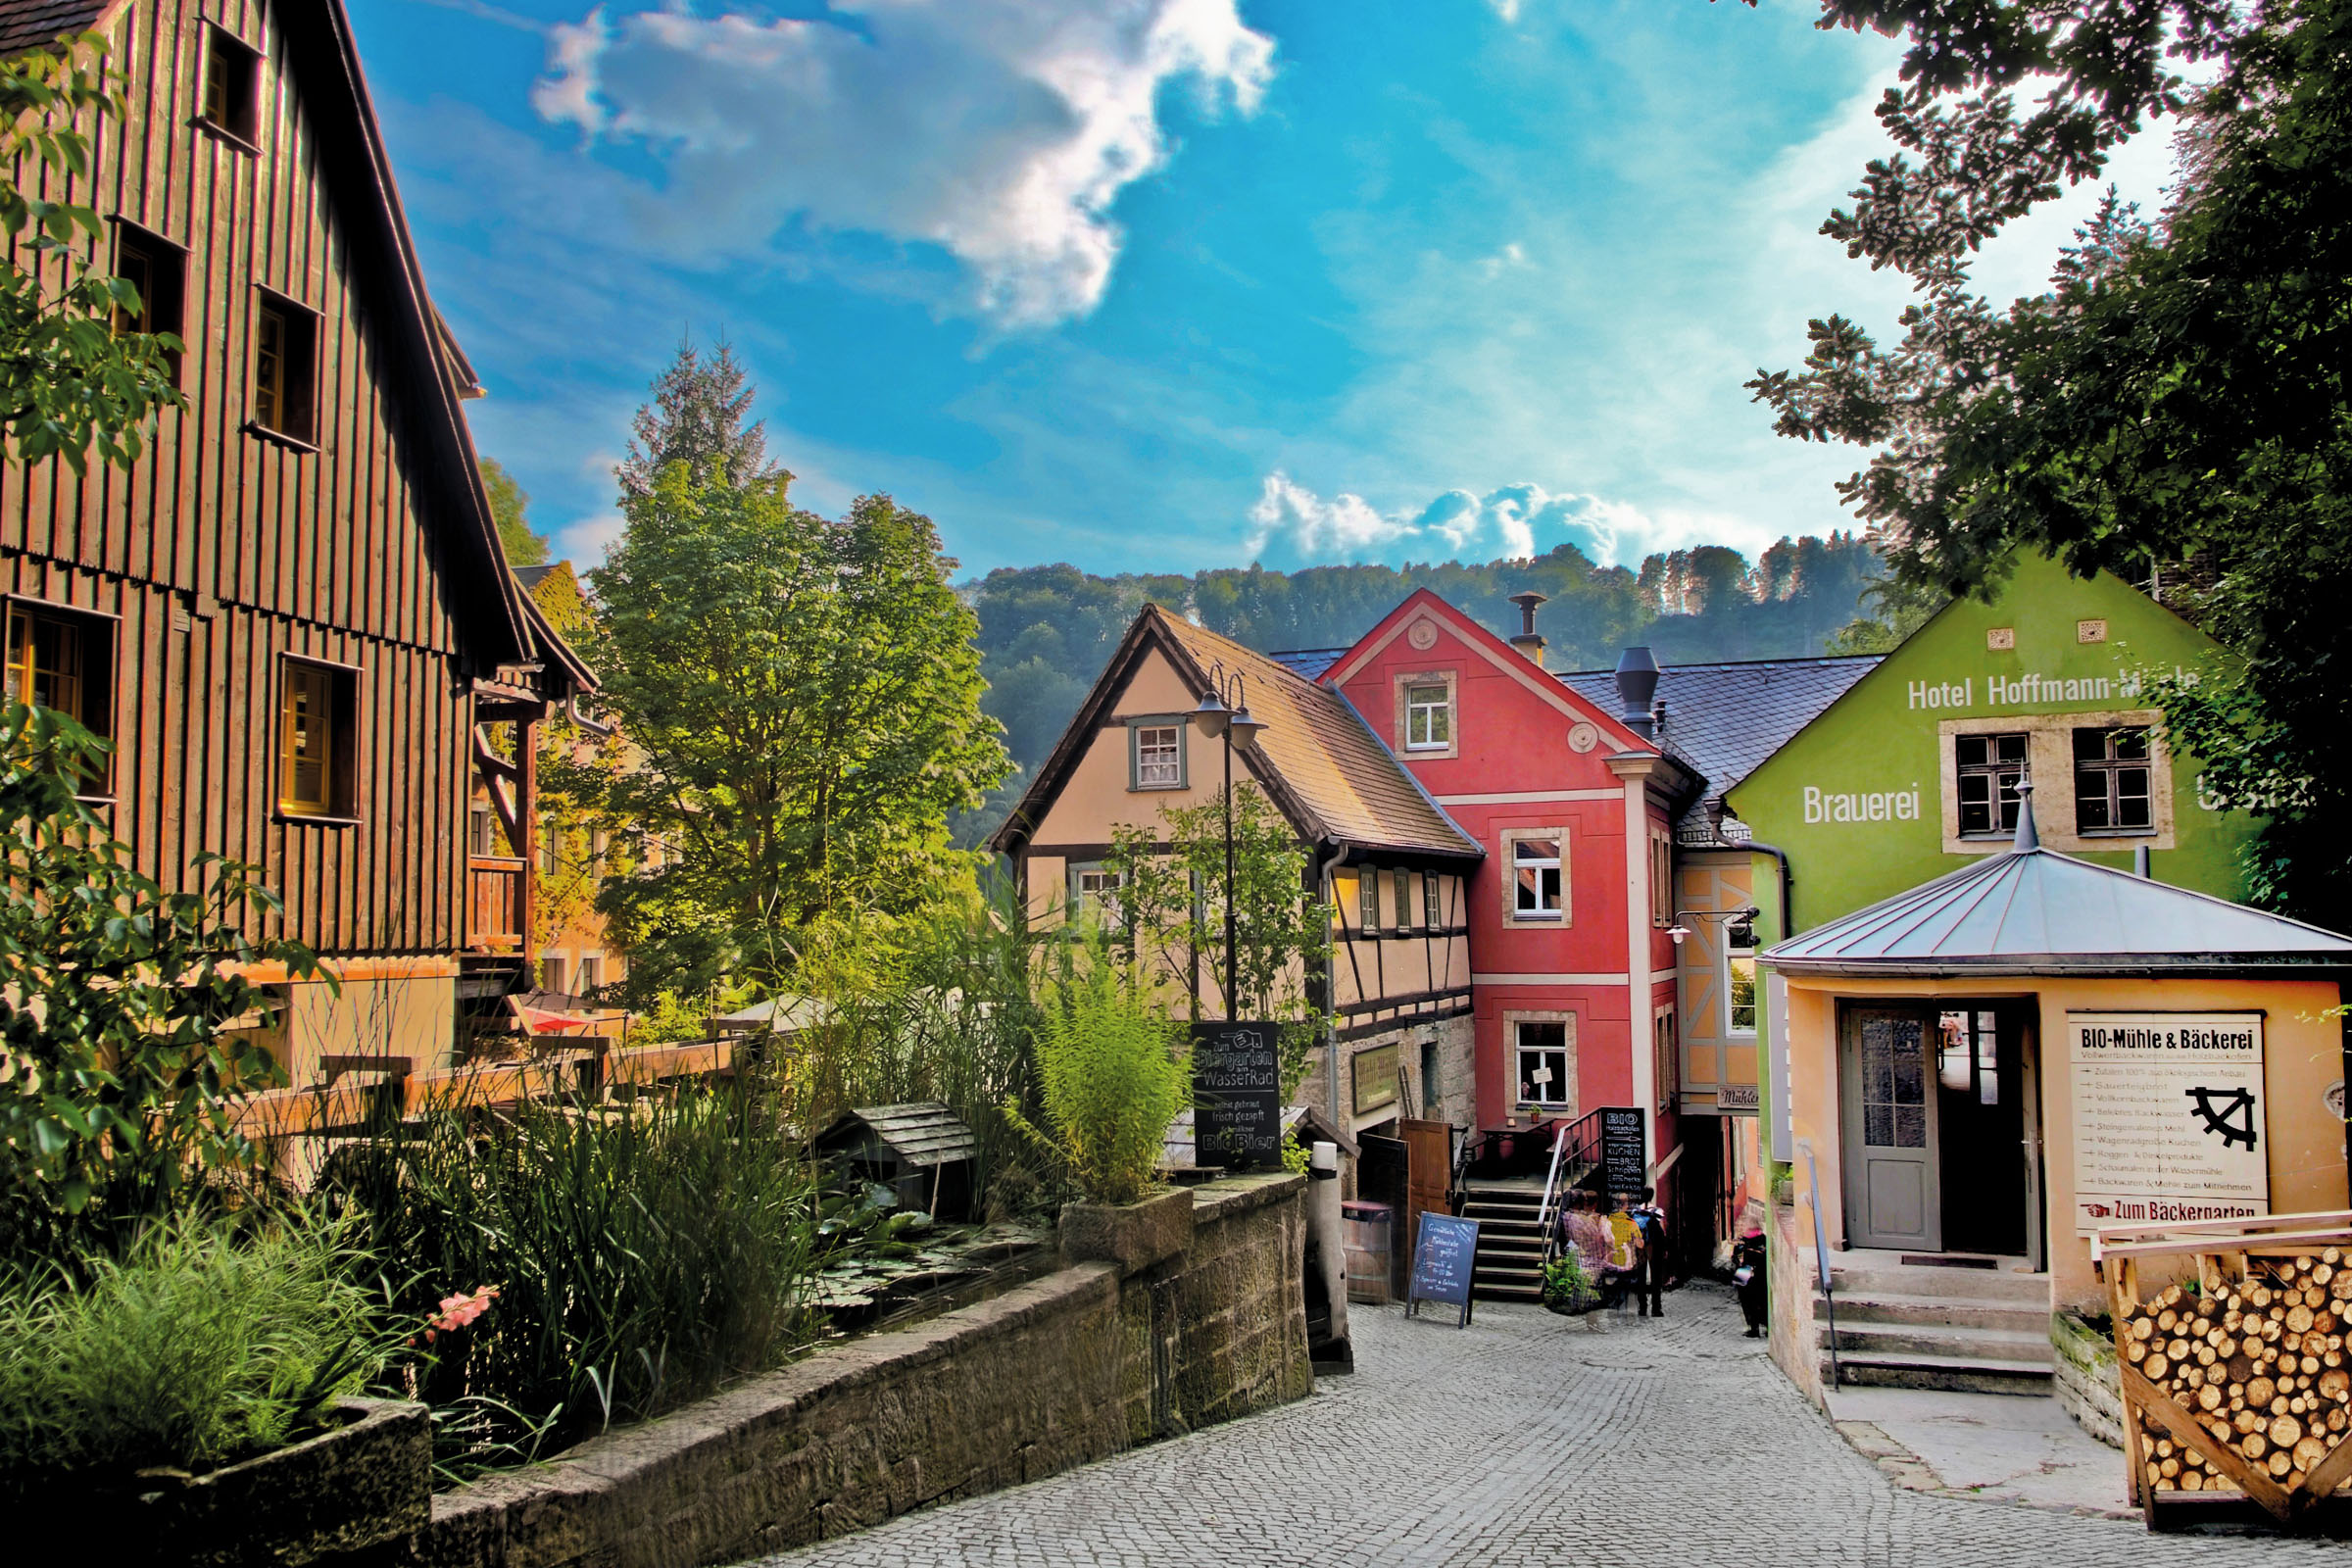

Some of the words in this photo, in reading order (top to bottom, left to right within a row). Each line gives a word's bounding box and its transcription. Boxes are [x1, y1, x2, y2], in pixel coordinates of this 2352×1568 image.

[1908, 678, 1972, 710] Hotel
[1988, 665, 2200, 706] Hoffmann-Mle
[1804, 782, 1919, 823] Brauerei
[1213, 1042, 1230, 1052] Zum
[2082, 1029, 2162, 1049] BIO-Mühle
[2166, 1032, 2177, 1049] &
[2180, 1030, 2253, 1050] Bäckerei
[1198, 1049, 1273, 1072] Biergarten
[1203, 1068, 1274, 1087] WasserRad
[1607, 1113, 1638, 1125] BIO
[2115, 1200, 2145, 1219] Zum
